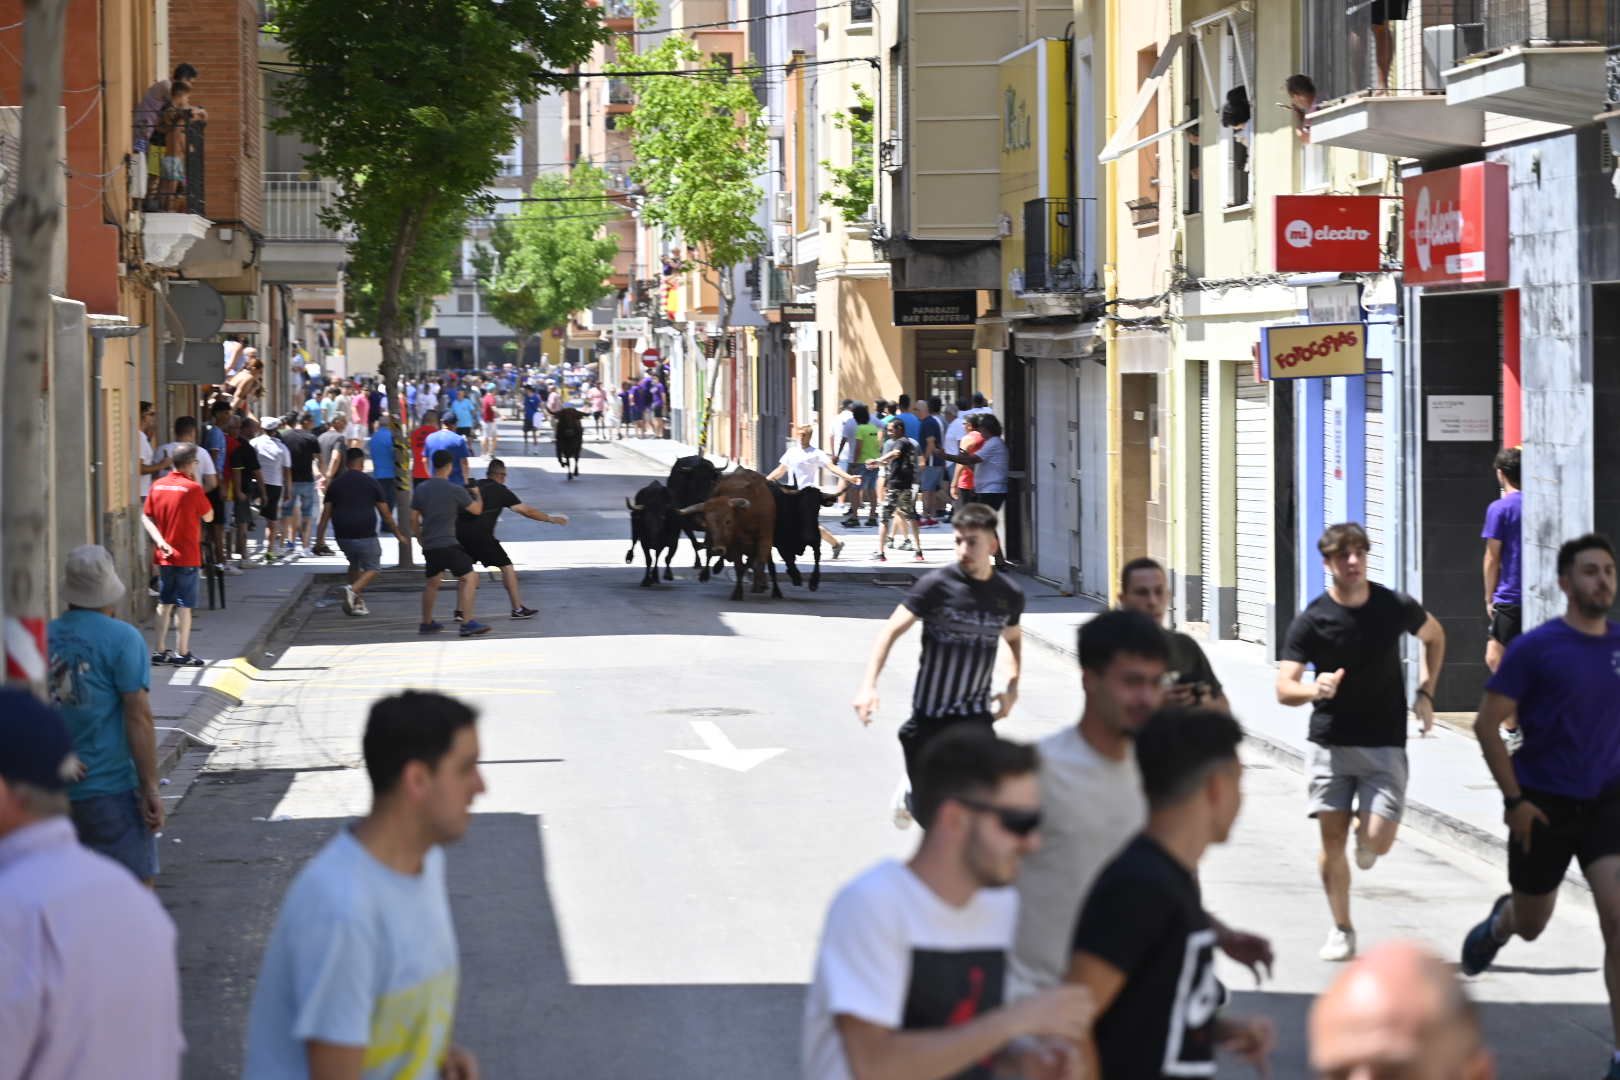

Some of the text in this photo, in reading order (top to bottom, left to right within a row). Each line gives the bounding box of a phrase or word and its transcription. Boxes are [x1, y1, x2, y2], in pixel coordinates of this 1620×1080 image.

[1290, 225, 1369, 240] mi electro
[1274, 331, 1358, 369] FOTOCOPIAS
